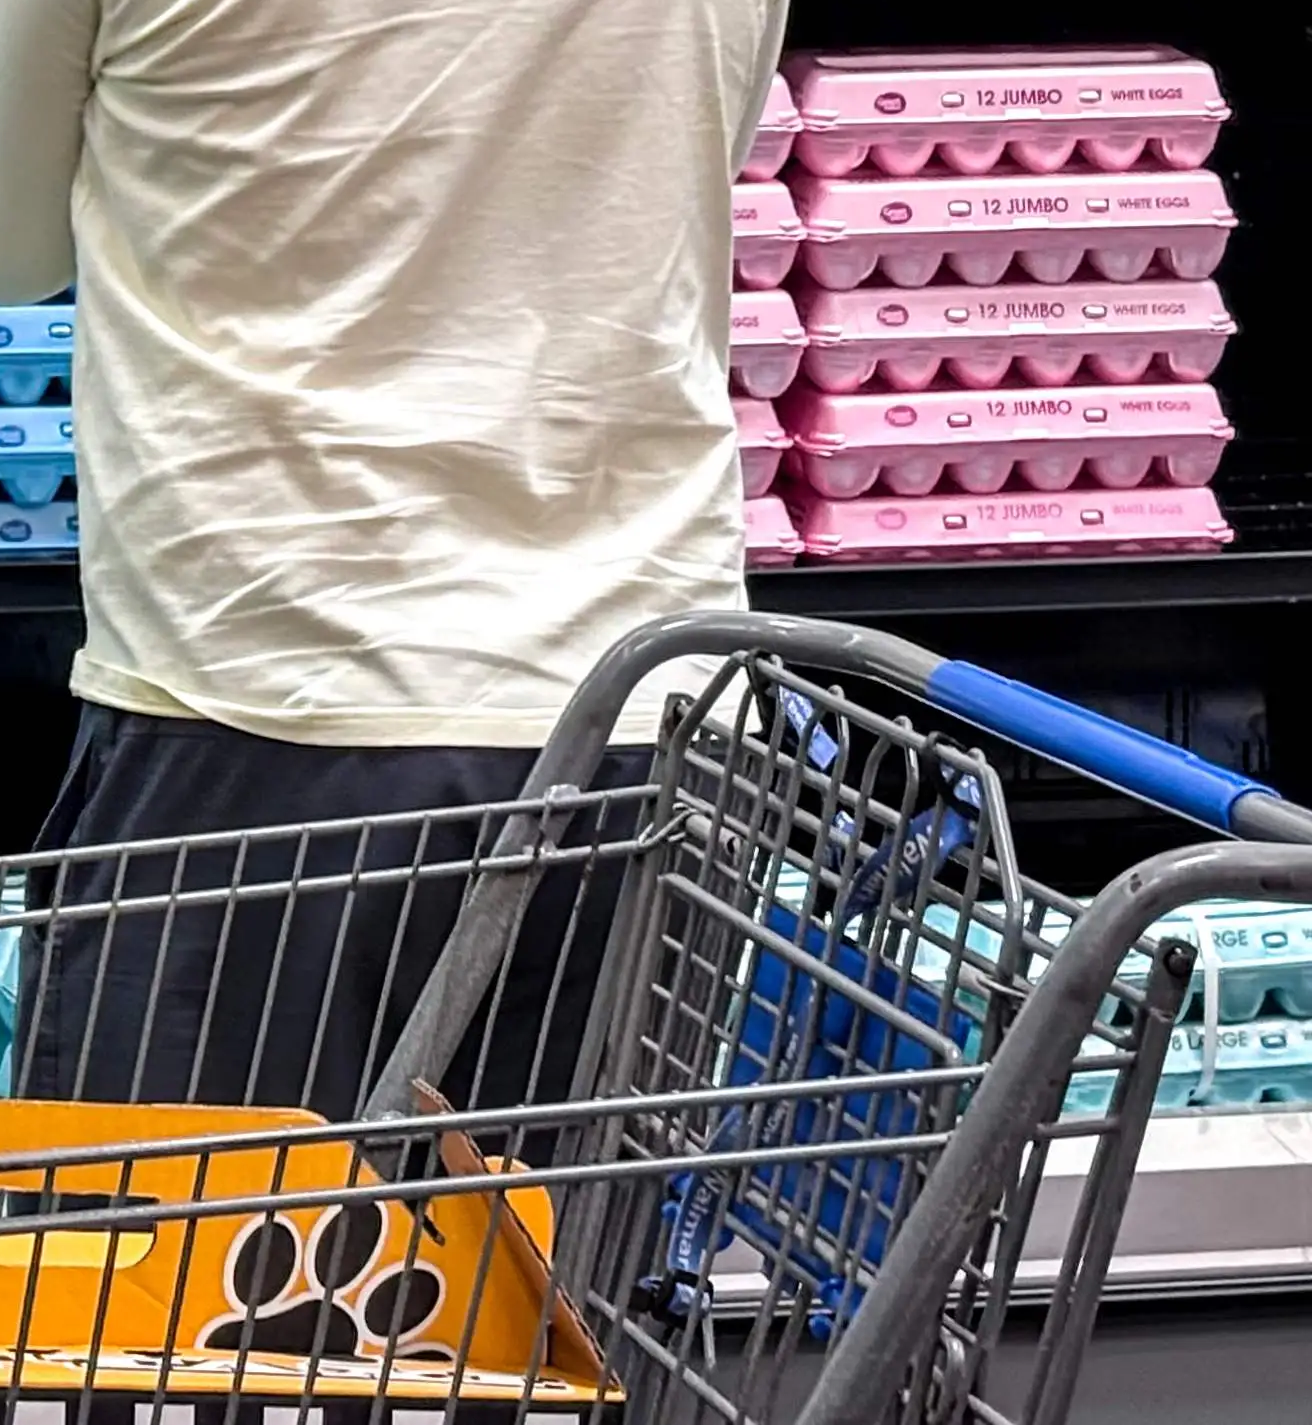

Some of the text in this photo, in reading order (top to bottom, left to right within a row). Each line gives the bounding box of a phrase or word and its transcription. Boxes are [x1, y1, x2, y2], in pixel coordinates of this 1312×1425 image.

[976, 89, 1182, 106] 12 JUMBO WHITE EGGS
[982, 197, 1189, 215] 12 JUMBO WHITE EGGS
[979, 302, 1065, 320] 12 JUMBO
[677, 1166, 727, 1268] Walmar
